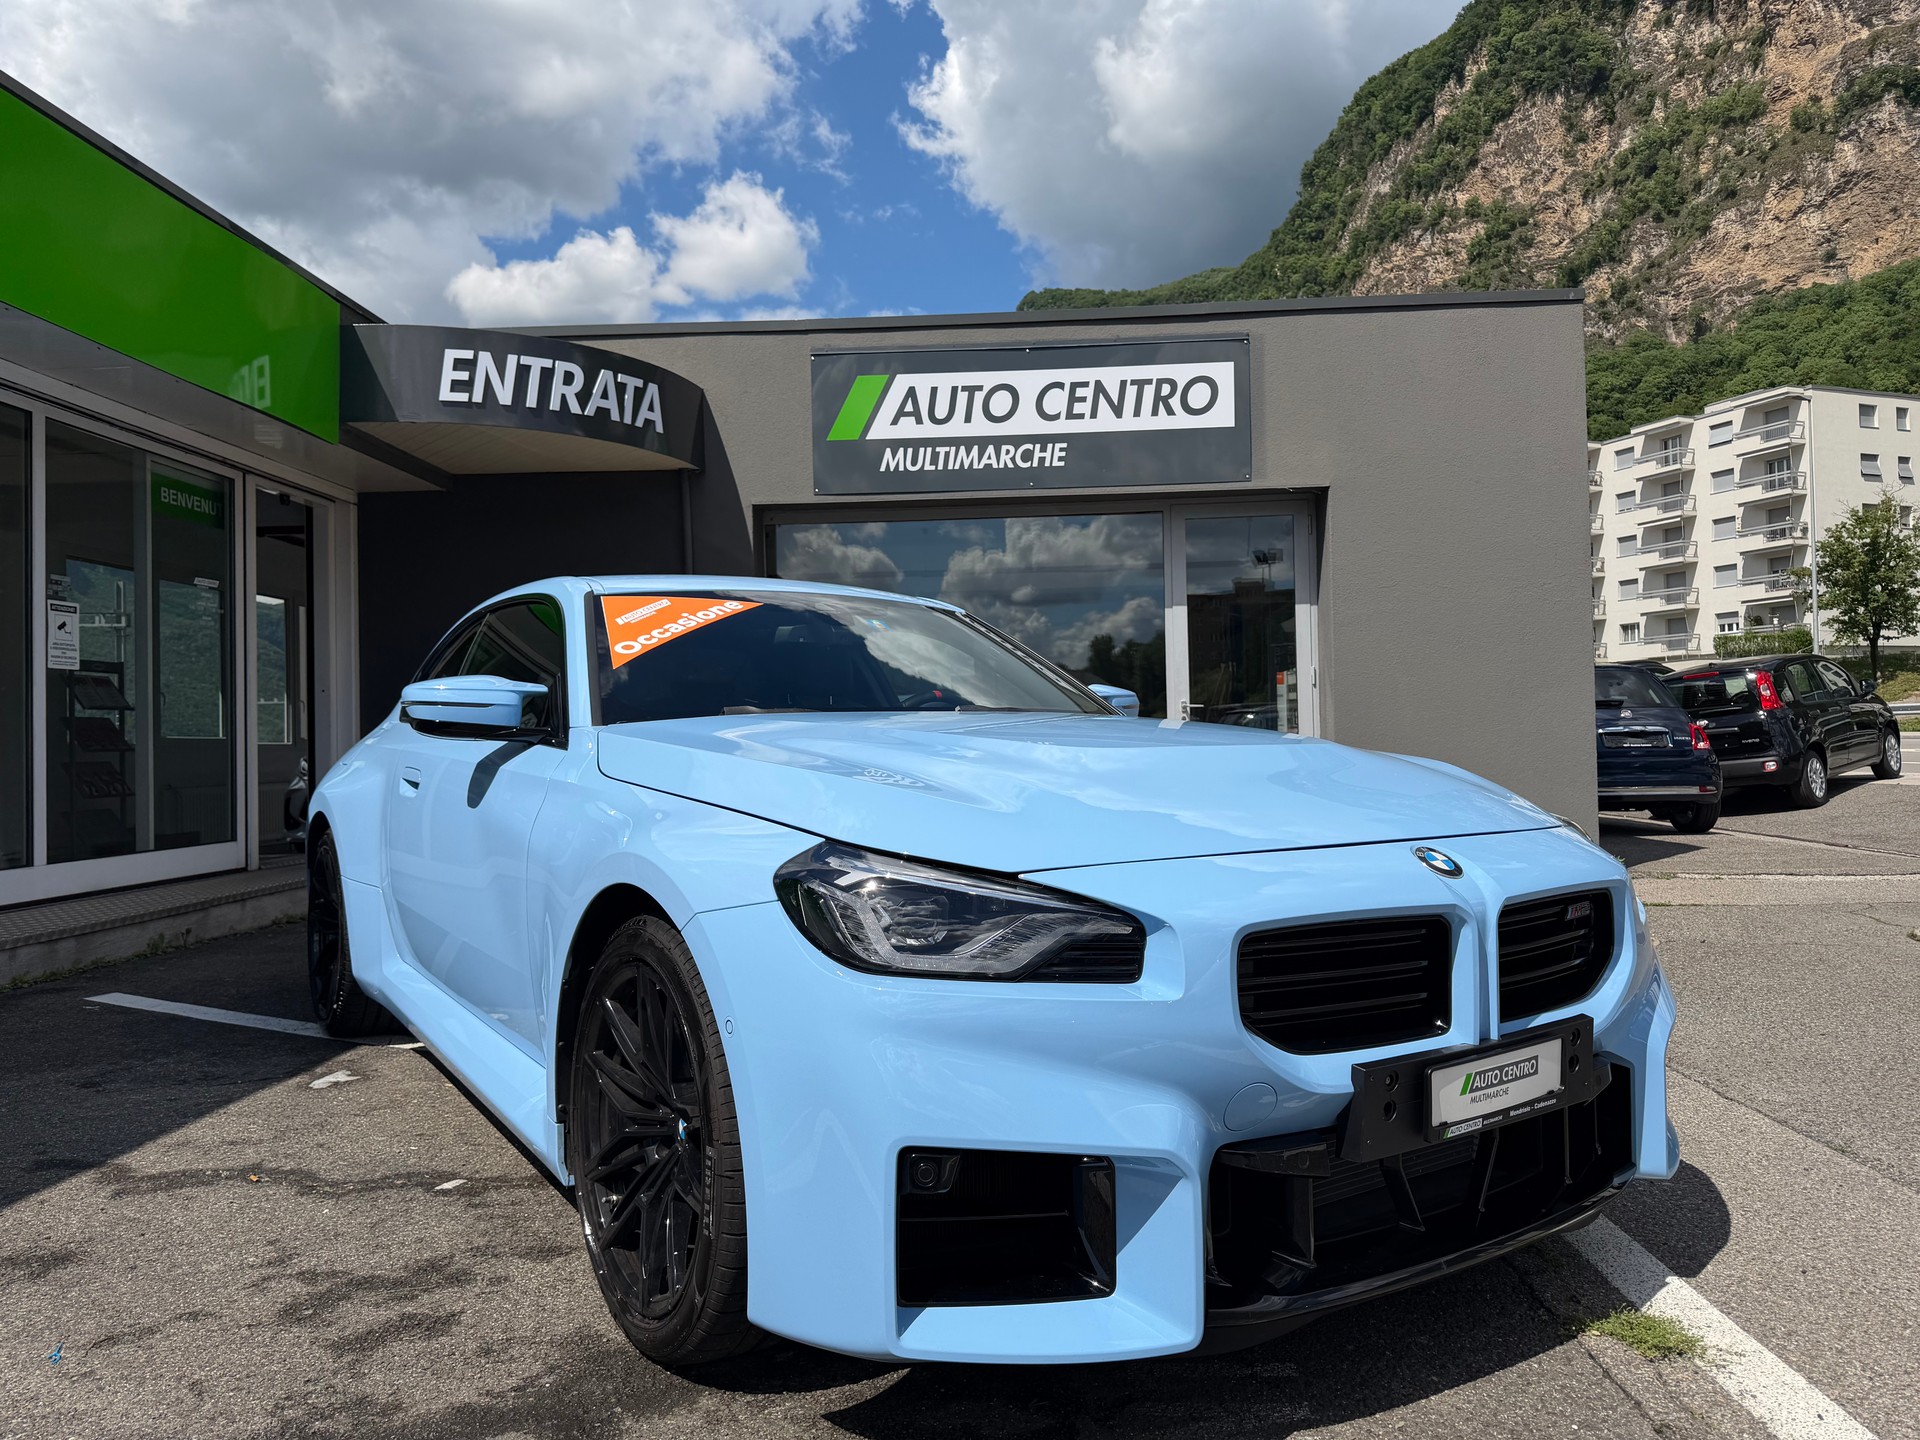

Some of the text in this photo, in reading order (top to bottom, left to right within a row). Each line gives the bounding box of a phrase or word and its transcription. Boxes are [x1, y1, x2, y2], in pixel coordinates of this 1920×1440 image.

[438, 348, 664, 434] ENTRATA
[890, 375, 1219, 426] AUTO CENTRO
[879, 442, 1068, 472] MULTIMARCHE
[614, 600, 745, 655] Occasione
[1473, 1059, 1537, 1090] AUTO CENTRO
[1469, 1087, 1510, 1105] MULTIMARCHE
[1449, 1125, 1463, 1135] AUTO
[1463, 1120, 1481, 1131] CENTRO
